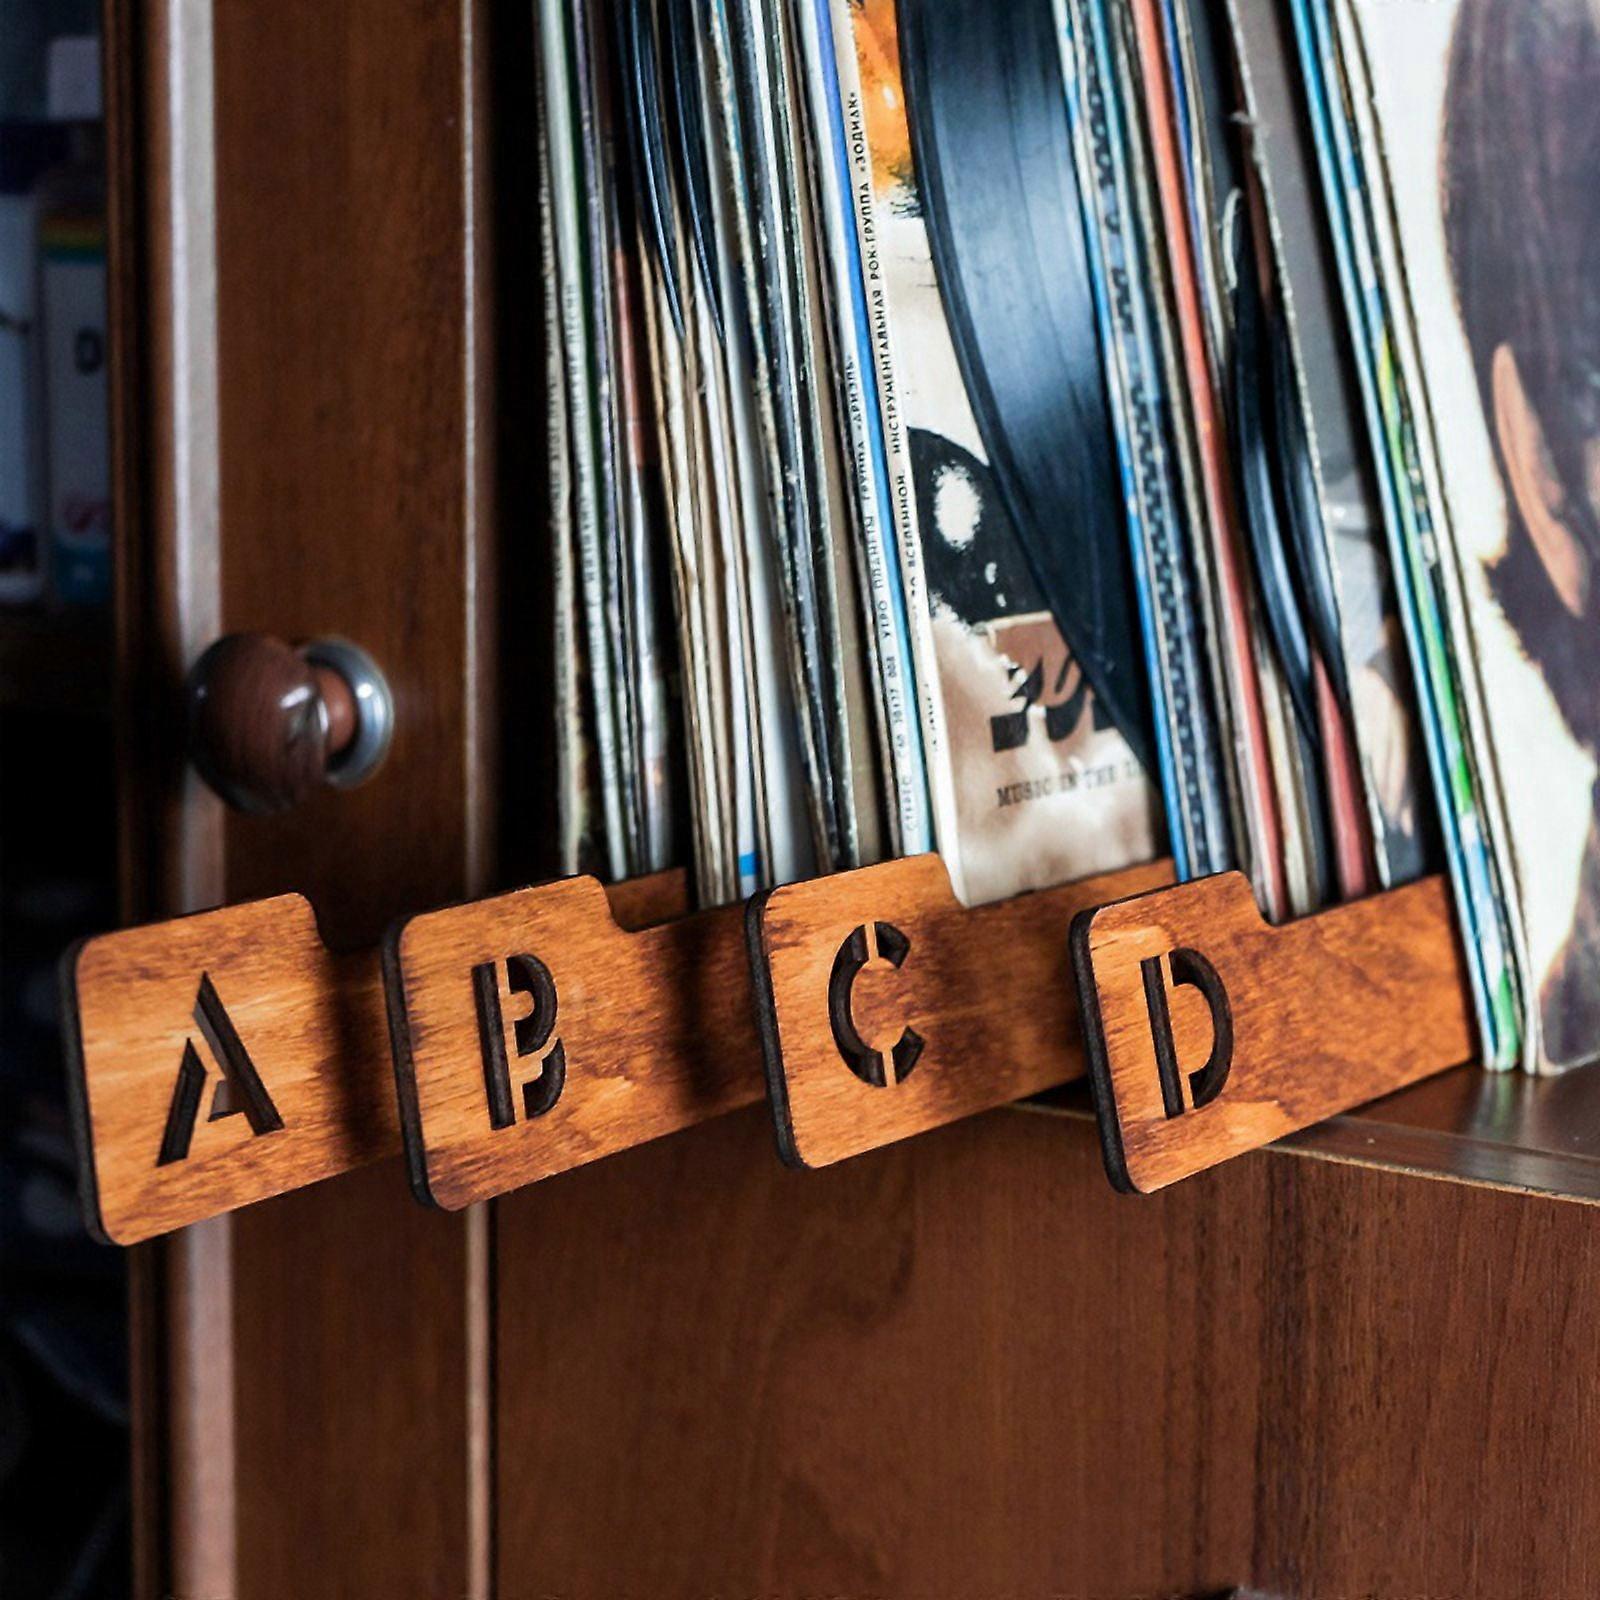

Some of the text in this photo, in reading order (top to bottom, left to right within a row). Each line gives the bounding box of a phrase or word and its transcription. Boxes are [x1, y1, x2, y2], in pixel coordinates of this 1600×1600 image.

[846, 91, 866, 173] «ЗОДИАК»
[858, 182, 880, 281] РОК-ГРУППА
[871, 289, 901, 455] ИНСТРУМЕНТАЛЬНАЯ
[856, 440, 871, 501] ГРУППА
[996, 777, 1052, 807] MUSIC
[1059, 771, 1078, 792] IN
[1083, 763, 1116, 790] THE
[156, 970, 285, 1167] A
[471, 952, 567, 1132] B
[827, 920, 926, 1088] C
[1139, 947, 1235, 1120] D
